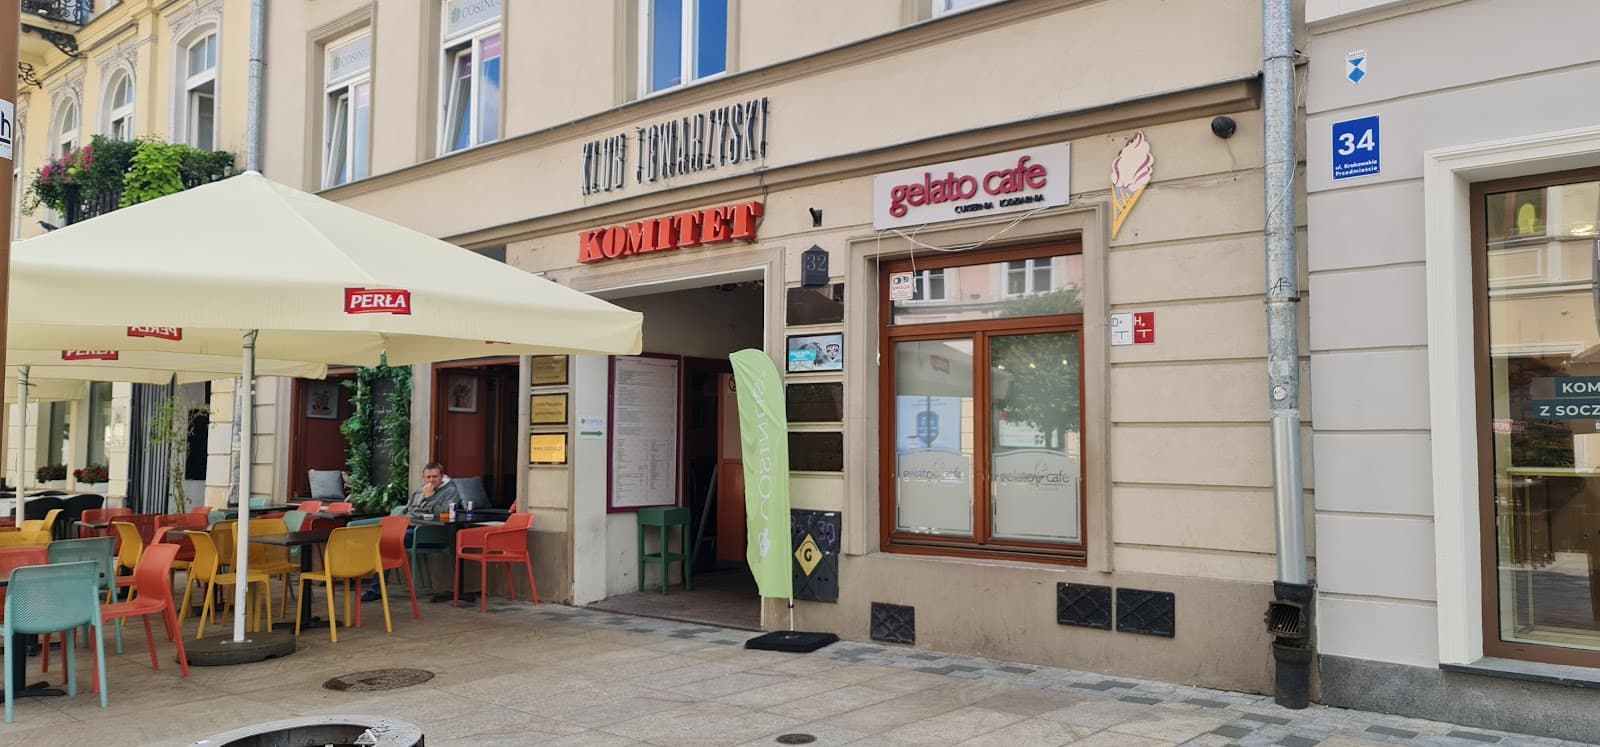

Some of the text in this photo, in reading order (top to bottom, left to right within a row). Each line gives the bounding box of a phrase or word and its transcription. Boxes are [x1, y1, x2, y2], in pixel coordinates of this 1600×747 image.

[582, 97, 768, 196] KLUB TOWARZYSKI
[1338, 128, 1375, 156] 34
[1344, 159, 1377, 169] Krakowskie
[889, 155, 1047, 218] gelato cafe
[577, 201, 764, 263] KOMITET
[807, 254, 826, 271] 32
[350, 293, 407, 309] PERŁA
[1539, 405, 1600, 416] Z SOCZ
[804, 547, 812, 562] G
